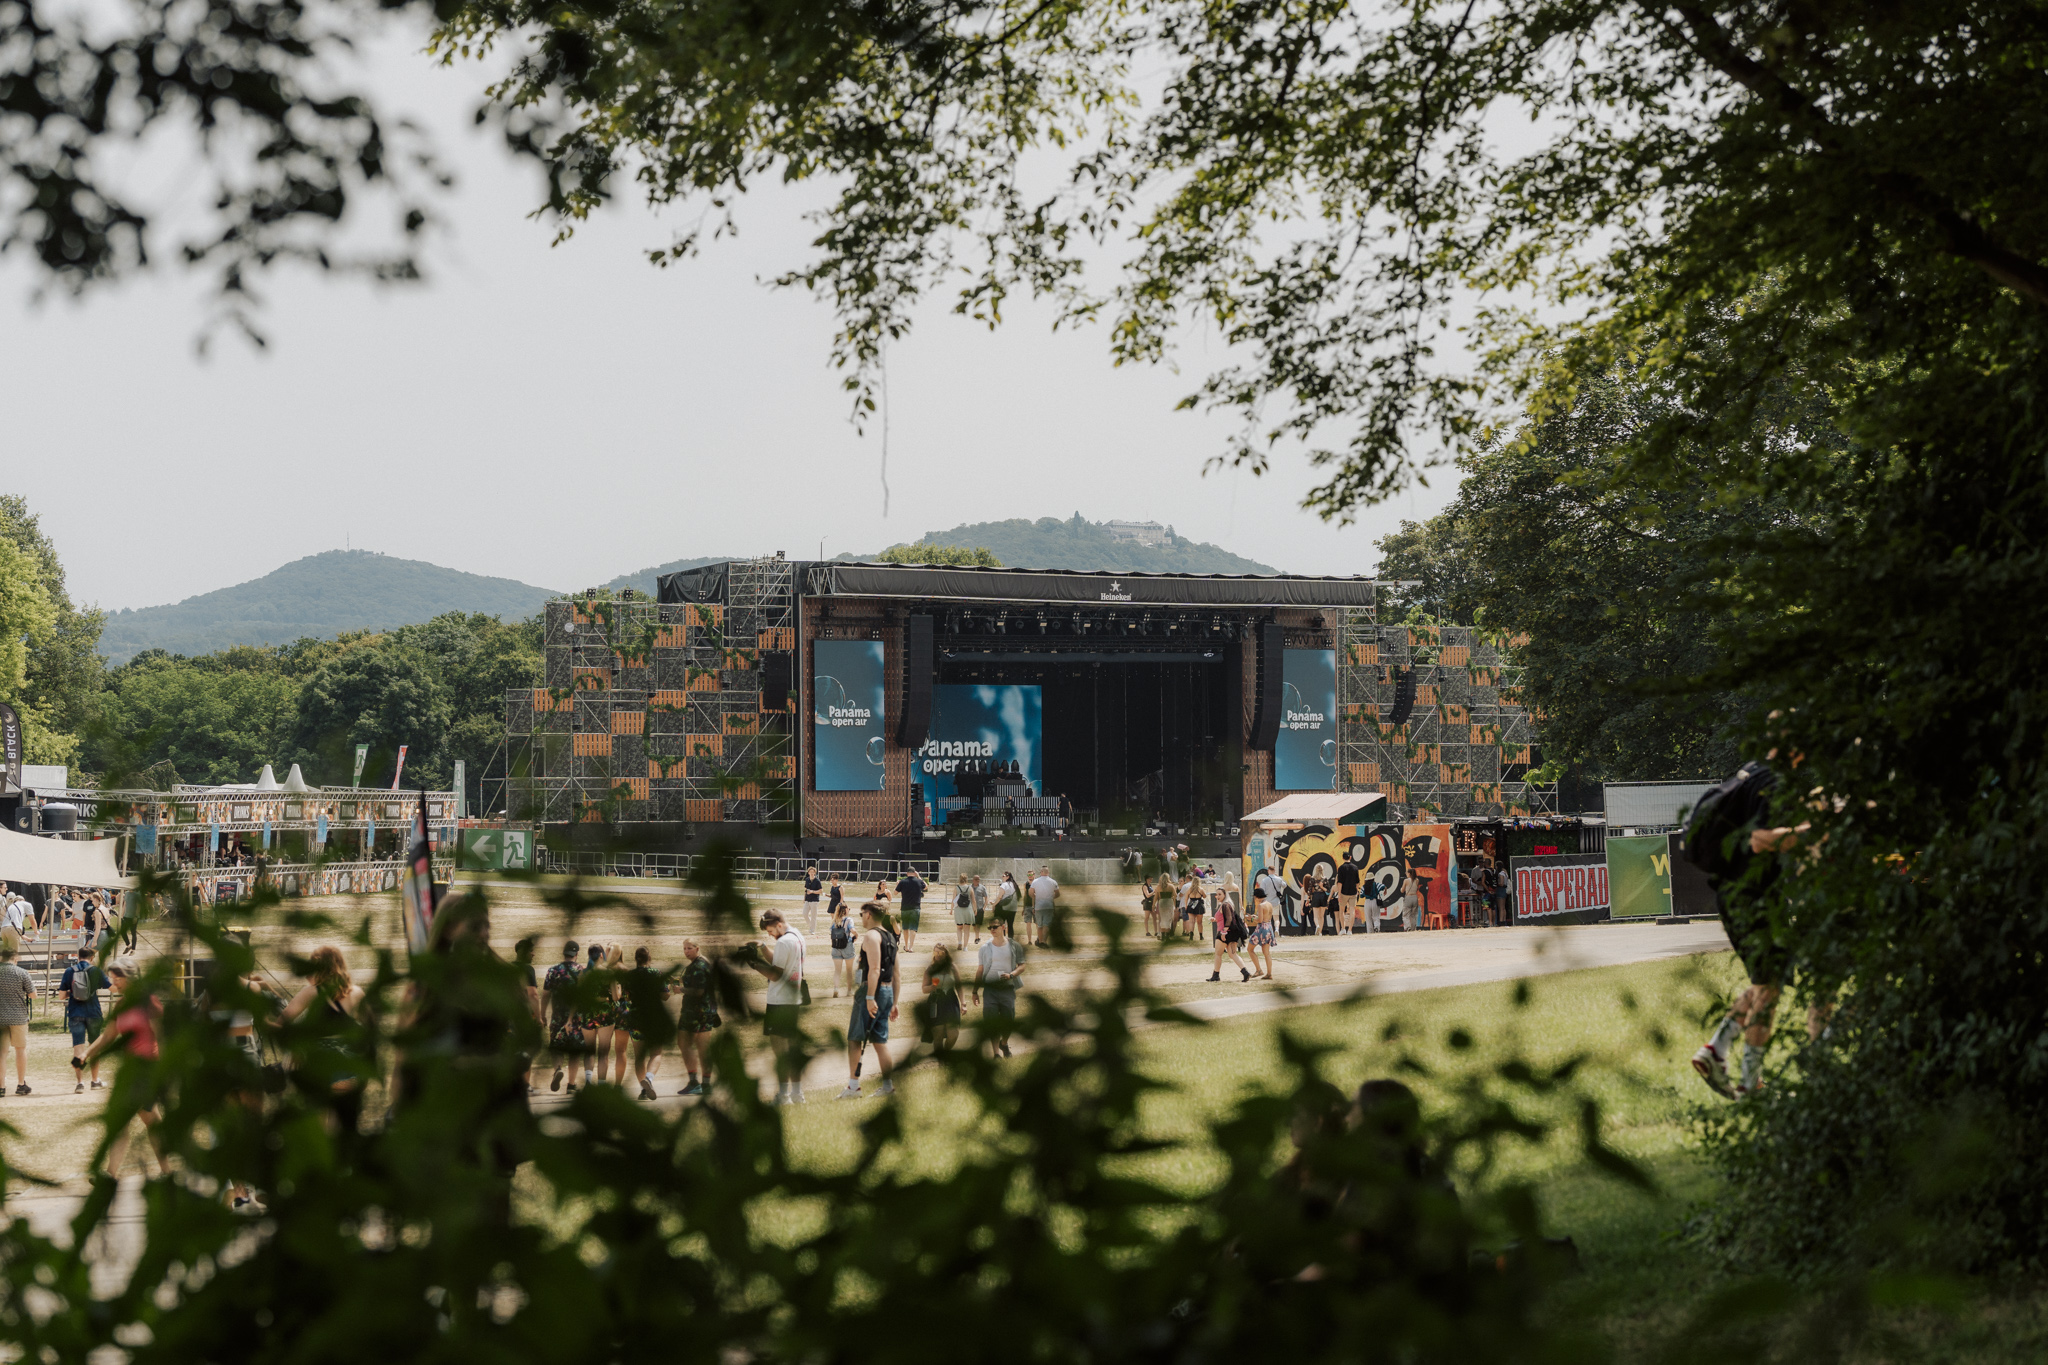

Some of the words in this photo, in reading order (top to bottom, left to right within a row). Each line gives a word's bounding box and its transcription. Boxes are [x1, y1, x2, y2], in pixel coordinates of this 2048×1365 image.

[1100, 592, 1132, 601] Heineken
[828, 705, 871, 718] Panama
[1287, 709, 1324, 721] Panama
[831, 718, 854, 728] open
[855, 718, 868, 726] air
[1289, 721, 1309, 731] open
[1310, 721, 1321, 729] air
[1517, 866, 1609, 916] DESPERAD
